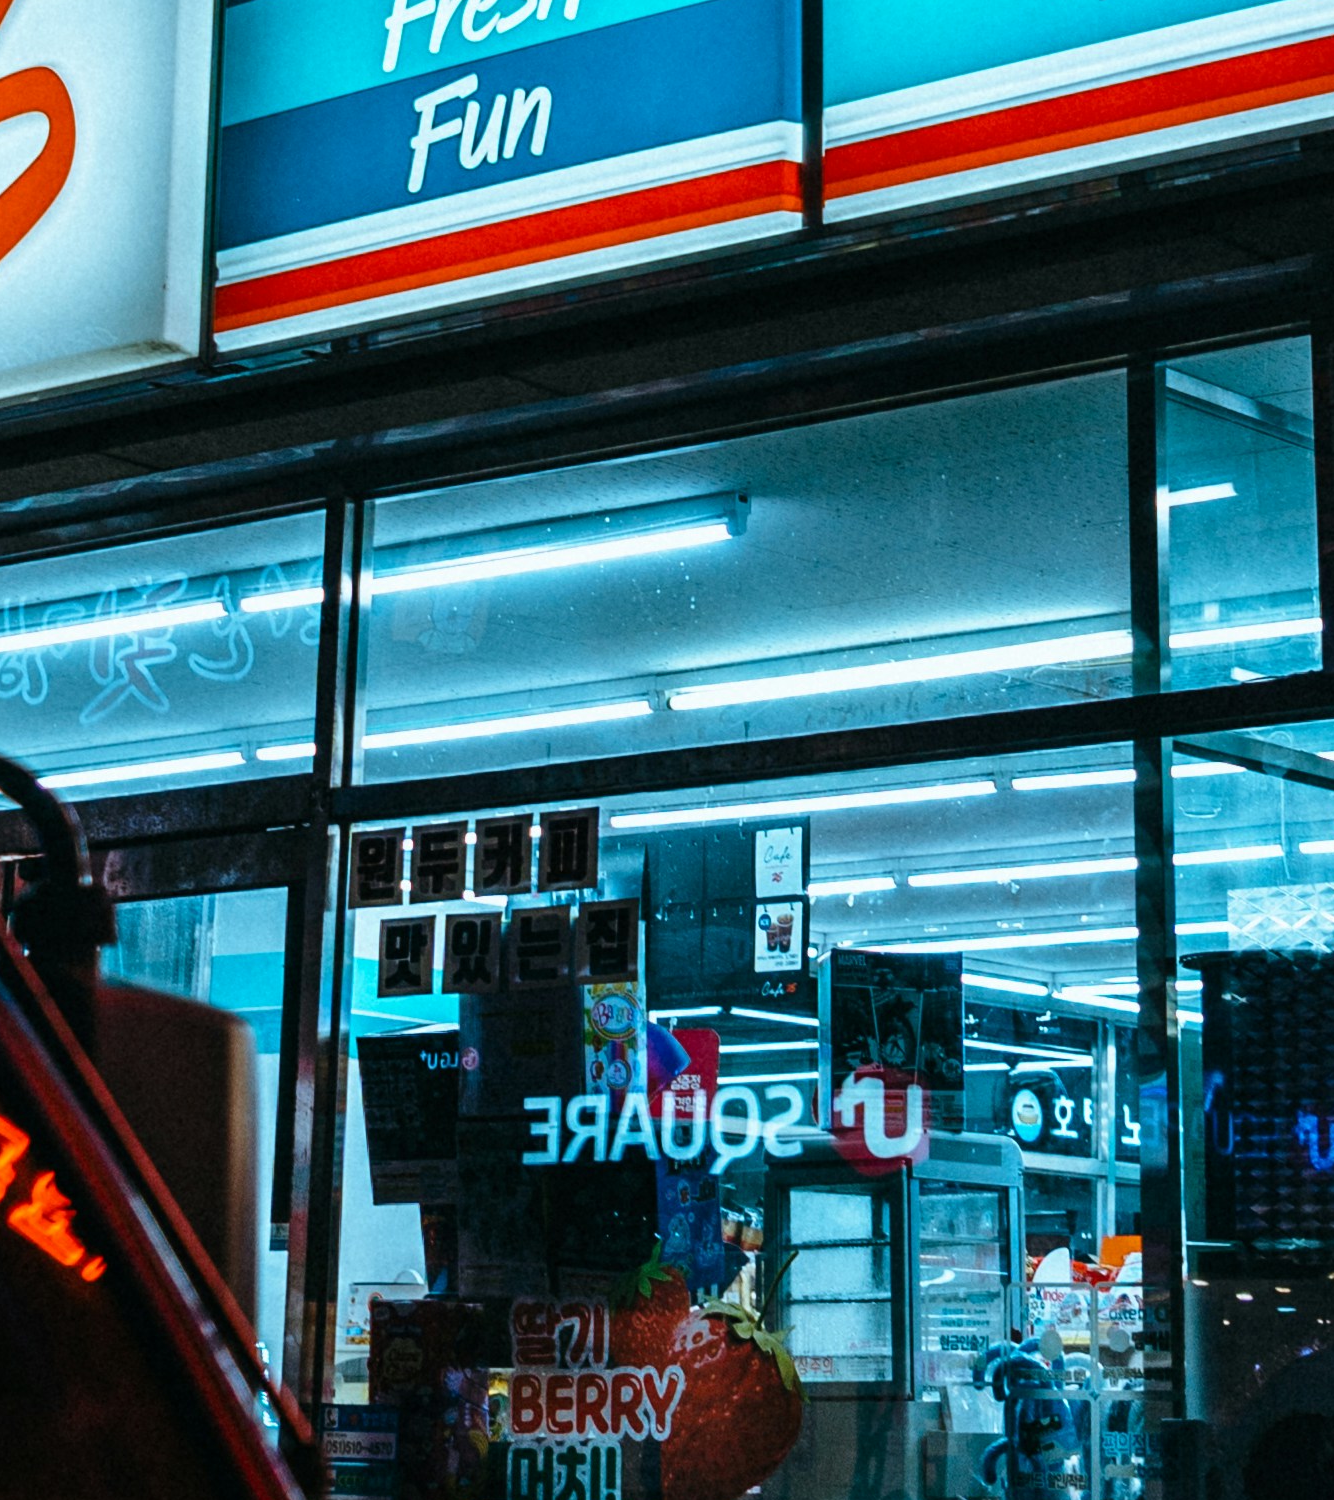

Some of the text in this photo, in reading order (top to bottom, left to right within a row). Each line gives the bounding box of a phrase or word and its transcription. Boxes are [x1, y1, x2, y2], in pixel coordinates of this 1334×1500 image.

[407, 74, 553, 194] Fun
[357, 816, 588, 900] 원두커피
[838, 953, 867, 967] MARVEL
[513, 1302, 607, 1367] 딸기
[510, 1370, 681, 1435] BERRY
